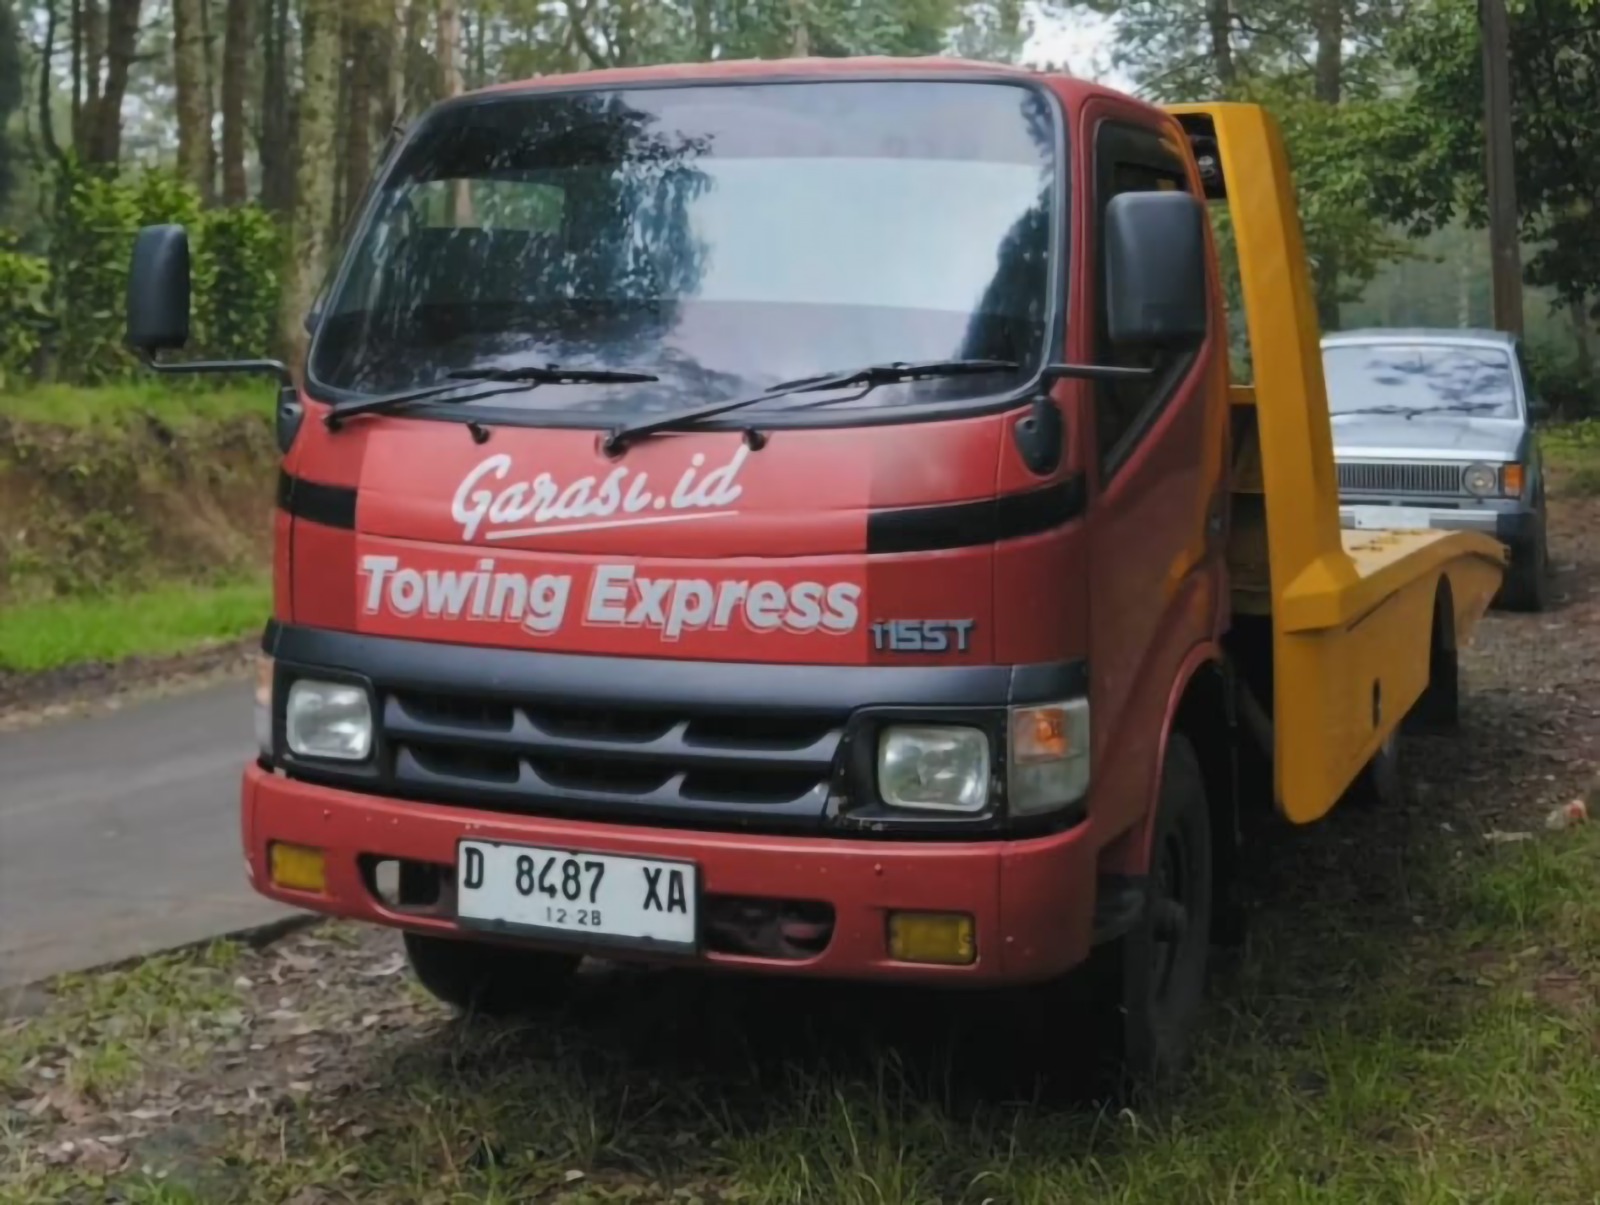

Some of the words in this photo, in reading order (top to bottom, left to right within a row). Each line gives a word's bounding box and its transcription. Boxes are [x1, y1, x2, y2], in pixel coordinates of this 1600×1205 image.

[451, 444, 746, 541] Garasi.id
[360, 554, 572, 635] Towing
[582, 563, 863, 642] Express
[463, 846, 485, 890] D
[515, 854, 605, 904] 8487
[643, 866, 687, 914] XA
